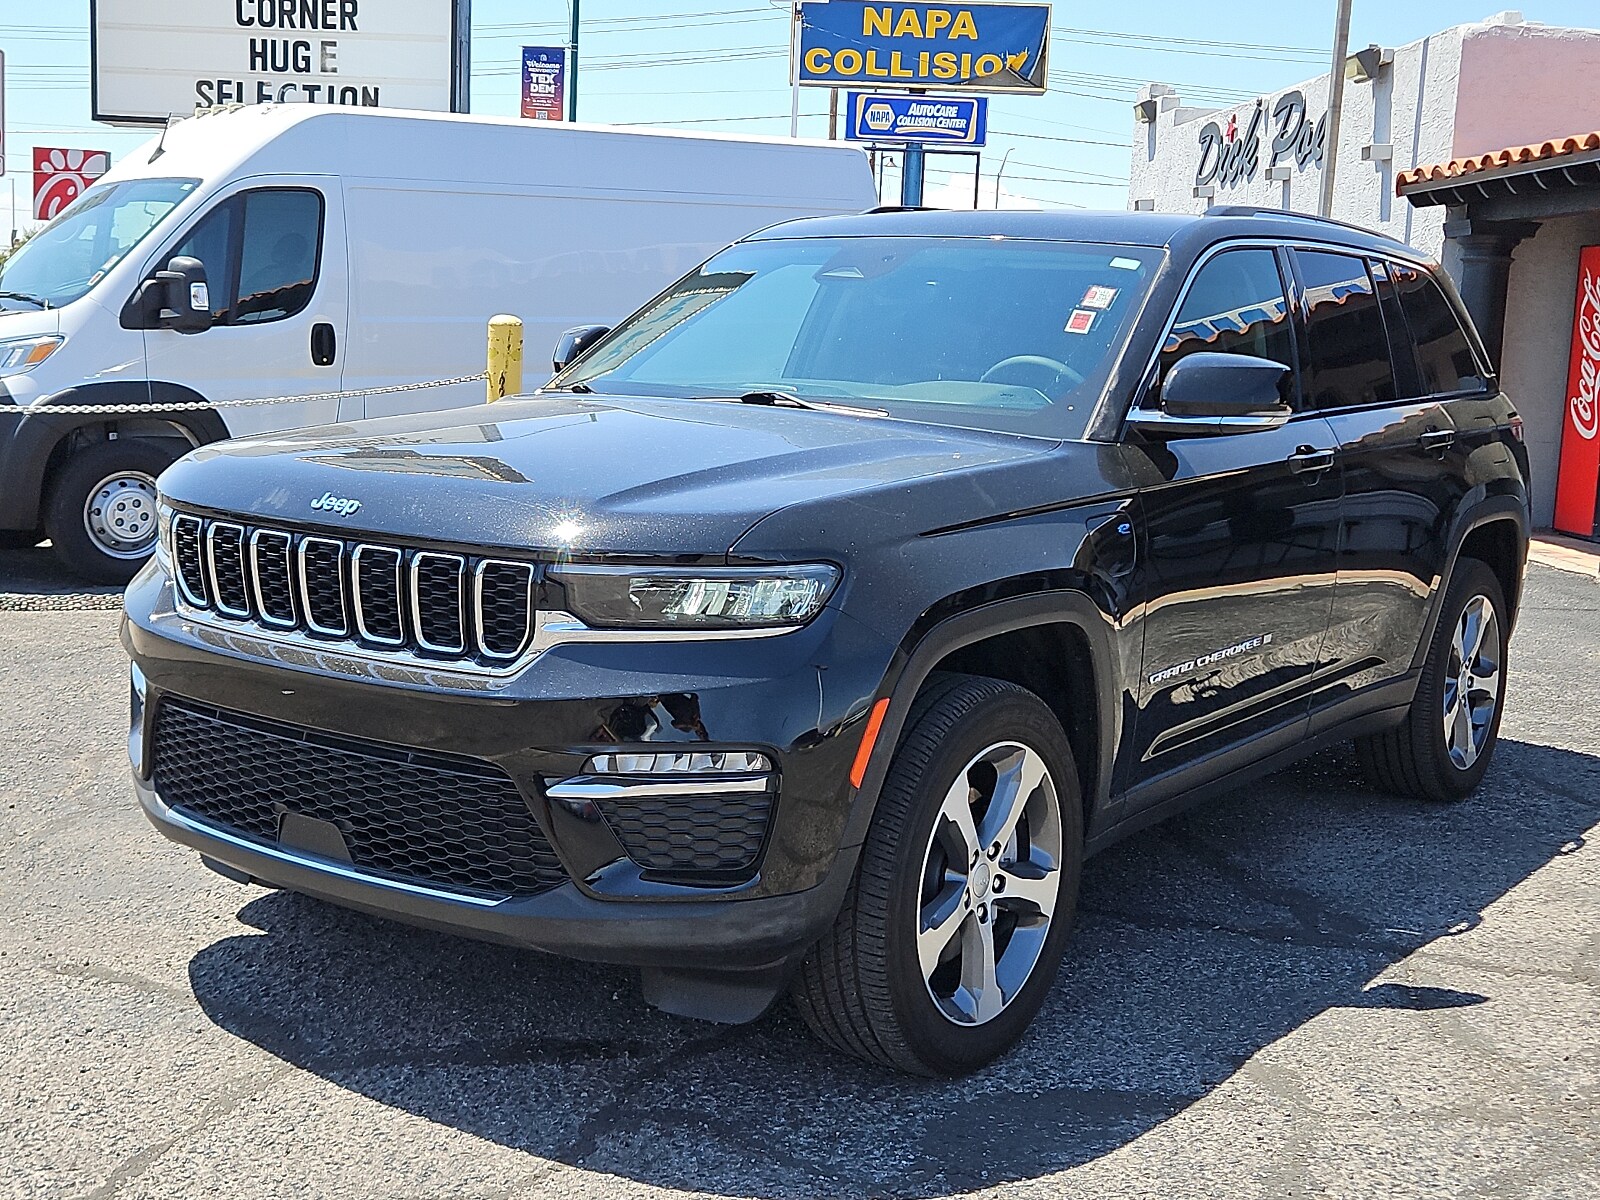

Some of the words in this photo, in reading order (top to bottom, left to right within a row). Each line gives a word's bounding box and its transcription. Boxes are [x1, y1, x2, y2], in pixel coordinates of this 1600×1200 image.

[235, 0, 359, 31] CORNER
[862, 7, 979, 40] NAPA
[249, 38, 338, 74] HUGE
[530, 73, 557, 84] TEX
[530, 84, 555, 94] DEM
[195, 79, 380, 109] SELECTION
[870, 111, 891, 123] NAPA
[896, 115, 937, 128] COLLISION
[936, 117, 967, 129] CENTER
[1196, 106, 1260, 185] Dick
[310, 491, 362, 516] Jeep
[1148, 660, 1196, 684] GRAND
[1195, 637, 1263, 668] CHEROKEE
